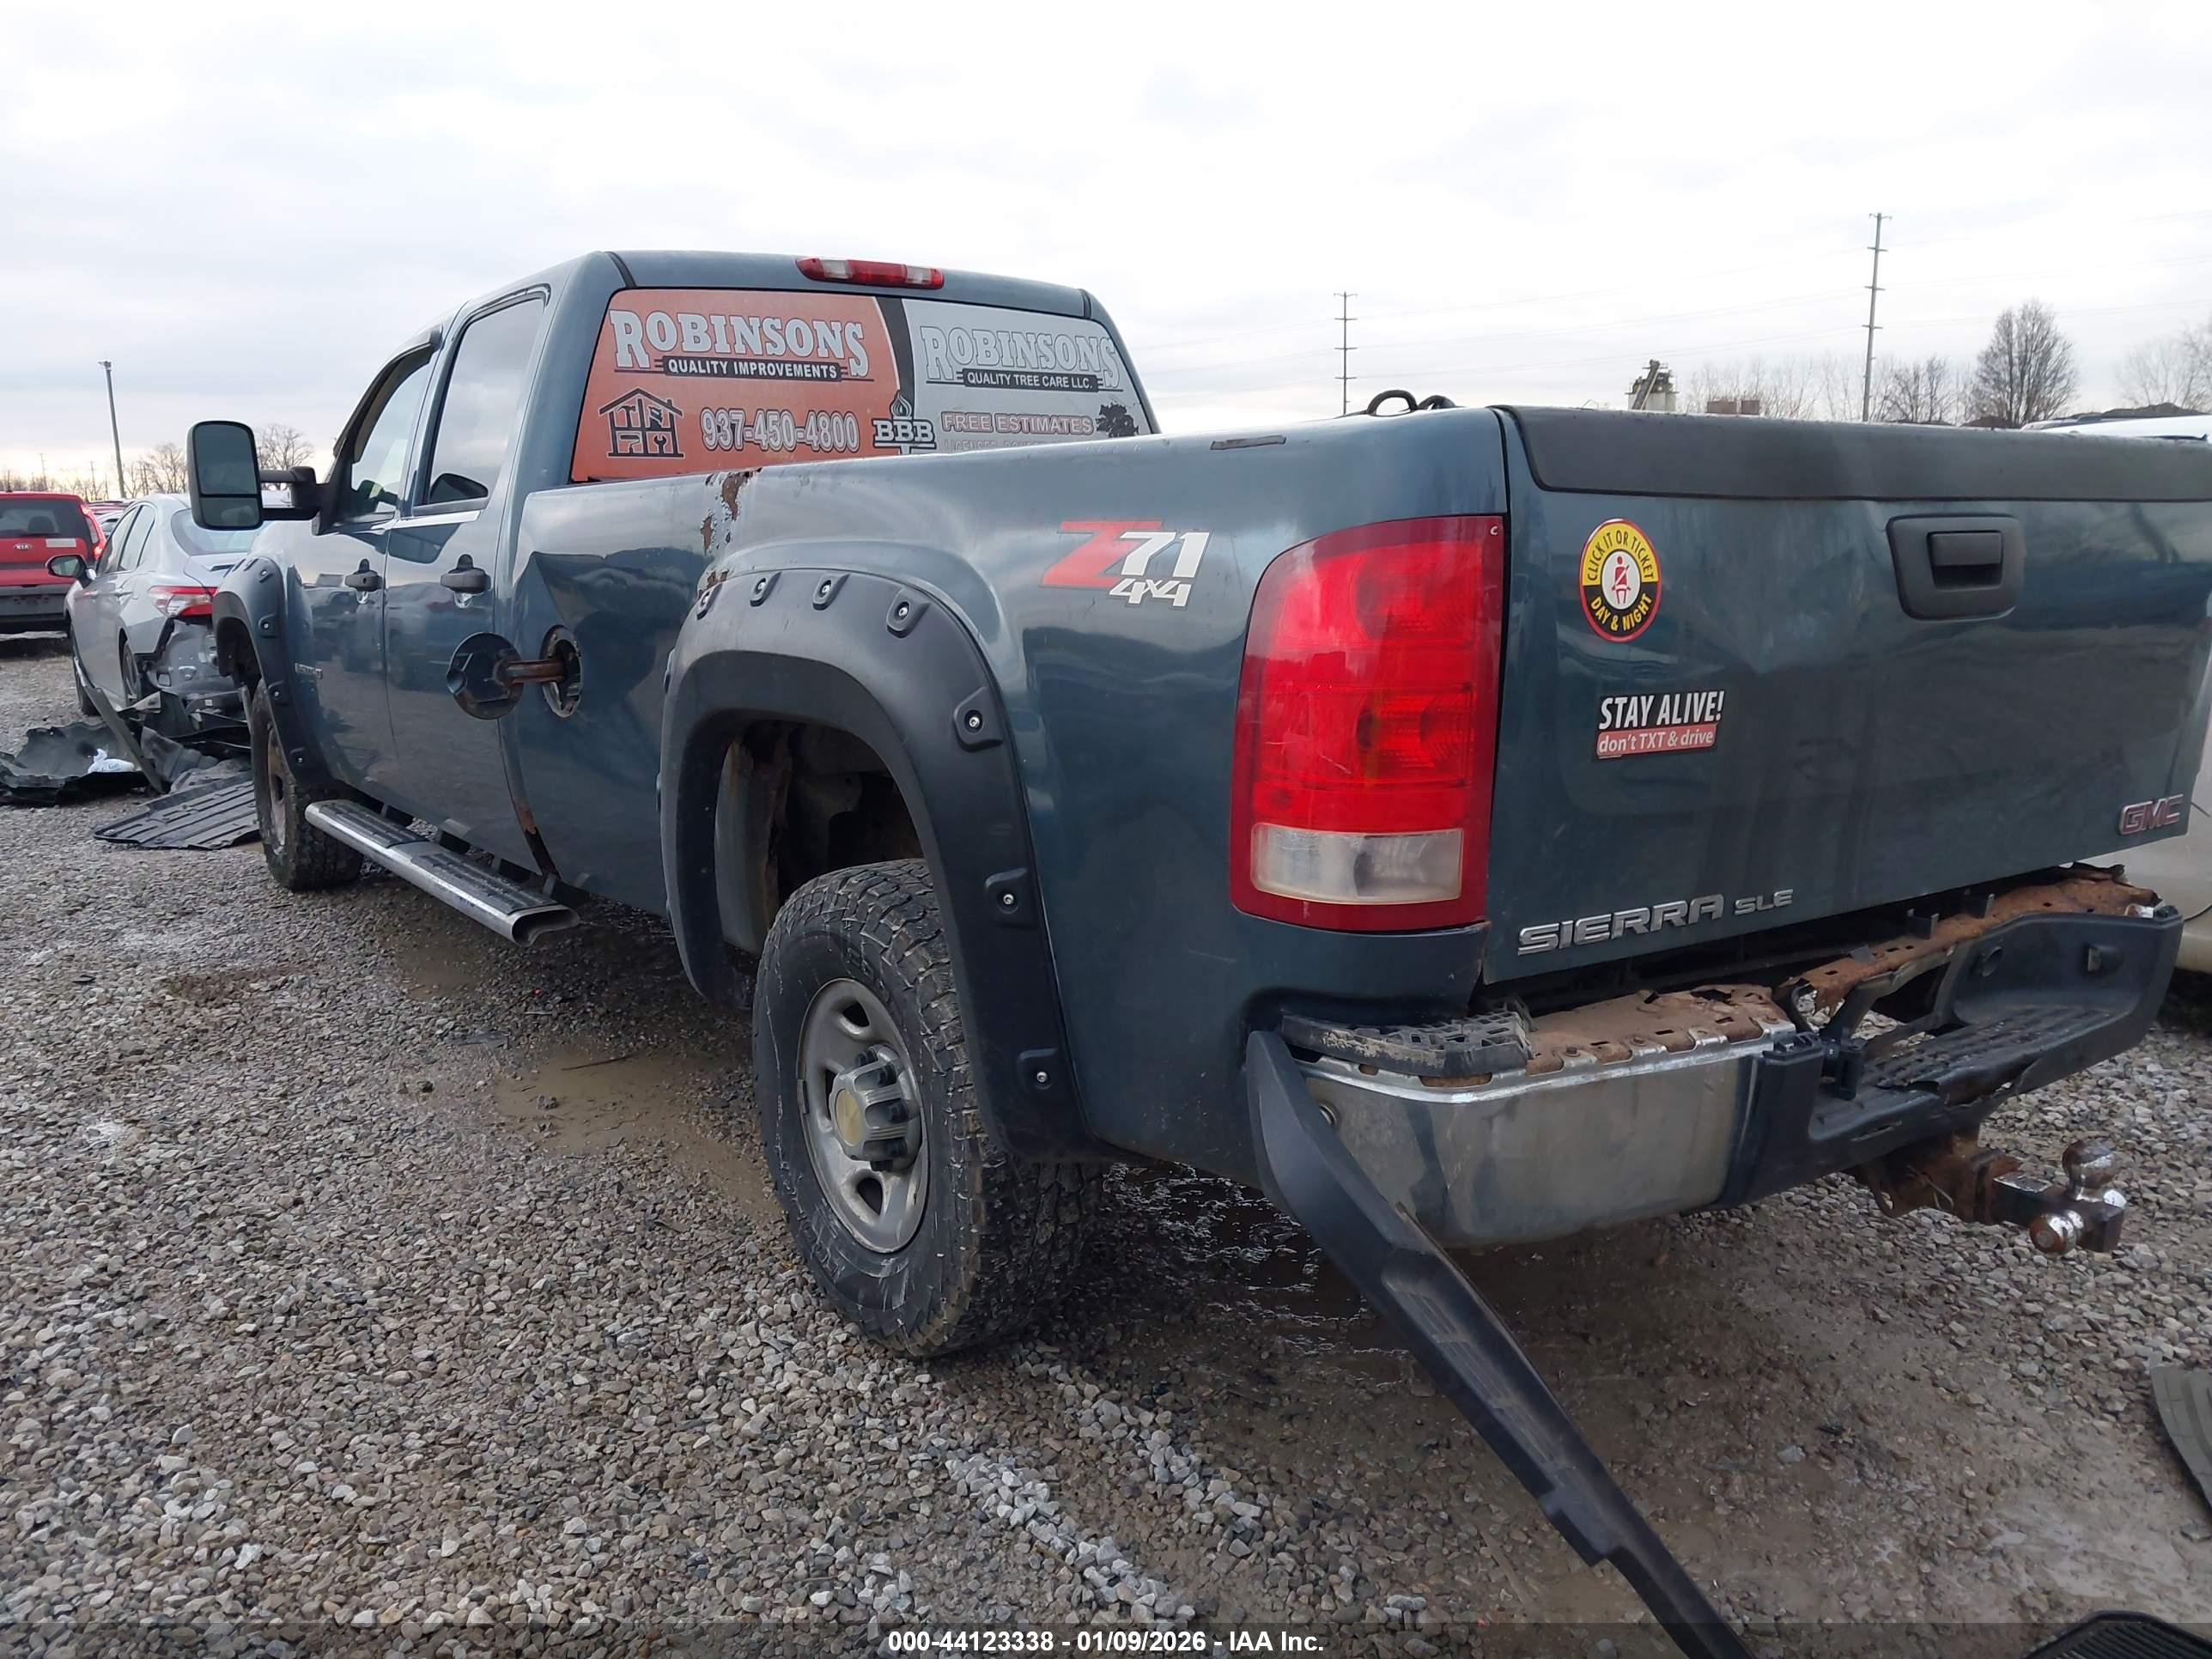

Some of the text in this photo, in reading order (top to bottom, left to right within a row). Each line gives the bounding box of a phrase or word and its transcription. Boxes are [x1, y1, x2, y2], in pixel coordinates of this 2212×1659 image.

[609, 309, 869, 377] ROBINSONS
[919, 325, 1121, 388] ROBINSONS
[668, 359, 838, 379] QUALITY IMPROVEMENTS
[967, 372, 1012, 385] QUALITY
[1013, 374, 1041, 386] TREE
[1042, 375, 1070, 388] CARE
[700, 407, 860, 453] 937-450-4800
[872, 419, 934, 443] BBB
[941, 411, 1094, 435] FREE ESTIMATES
[1041, 520, 1211, 589] Z71
[1587, 530, 1655, 581] CLICK IT OR TICKET
[1590, 592, 1652, 631] DAY & NIGHT
[1599, 690, 1725, 730] STAY ALIVE!
[1599, 729, 1714, 753] don't TXT & drive
[2118, 793, 2185, 836] GMC
[1517, 889, 1794, 956] SIERRA SLE
